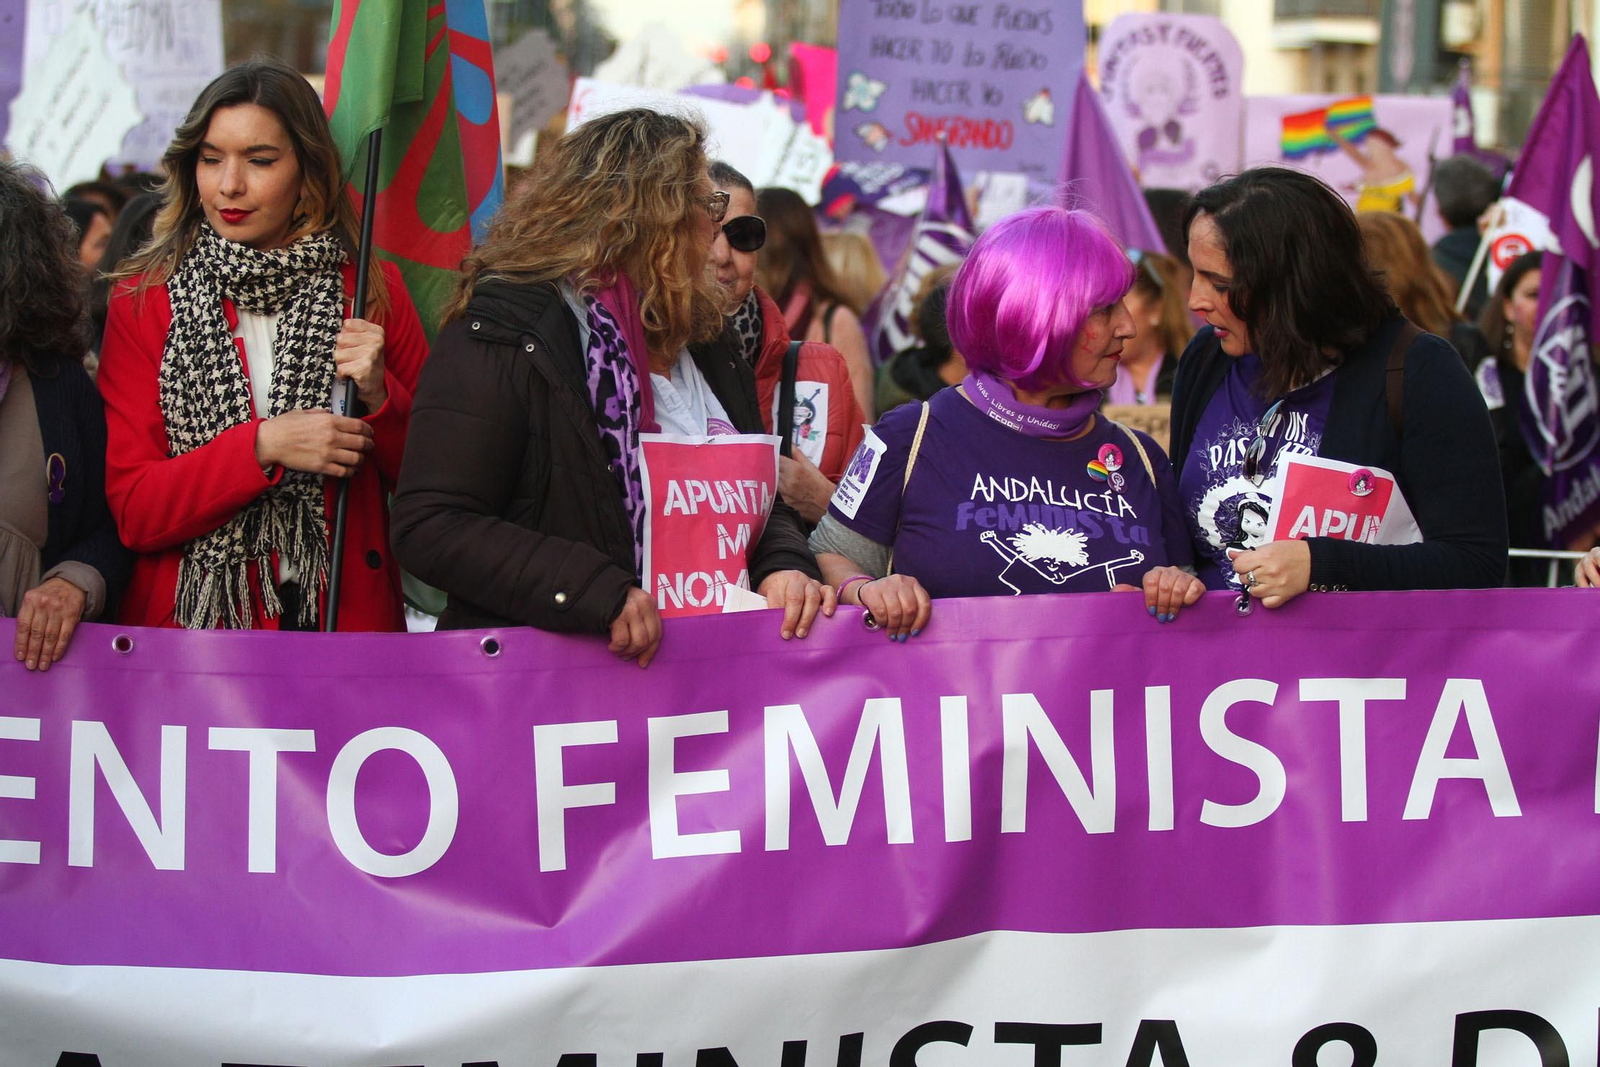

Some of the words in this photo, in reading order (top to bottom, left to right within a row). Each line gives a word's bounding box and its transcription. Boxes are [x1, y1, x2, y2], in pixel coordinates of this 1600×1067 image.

[990, 398, 1016, 418] Libres
[663, 479, 773, 517] APUNTA
[970, 472, 1137, 519] ANDALUCÍA
[533, 677, 1523, 873] FEMINISTA
